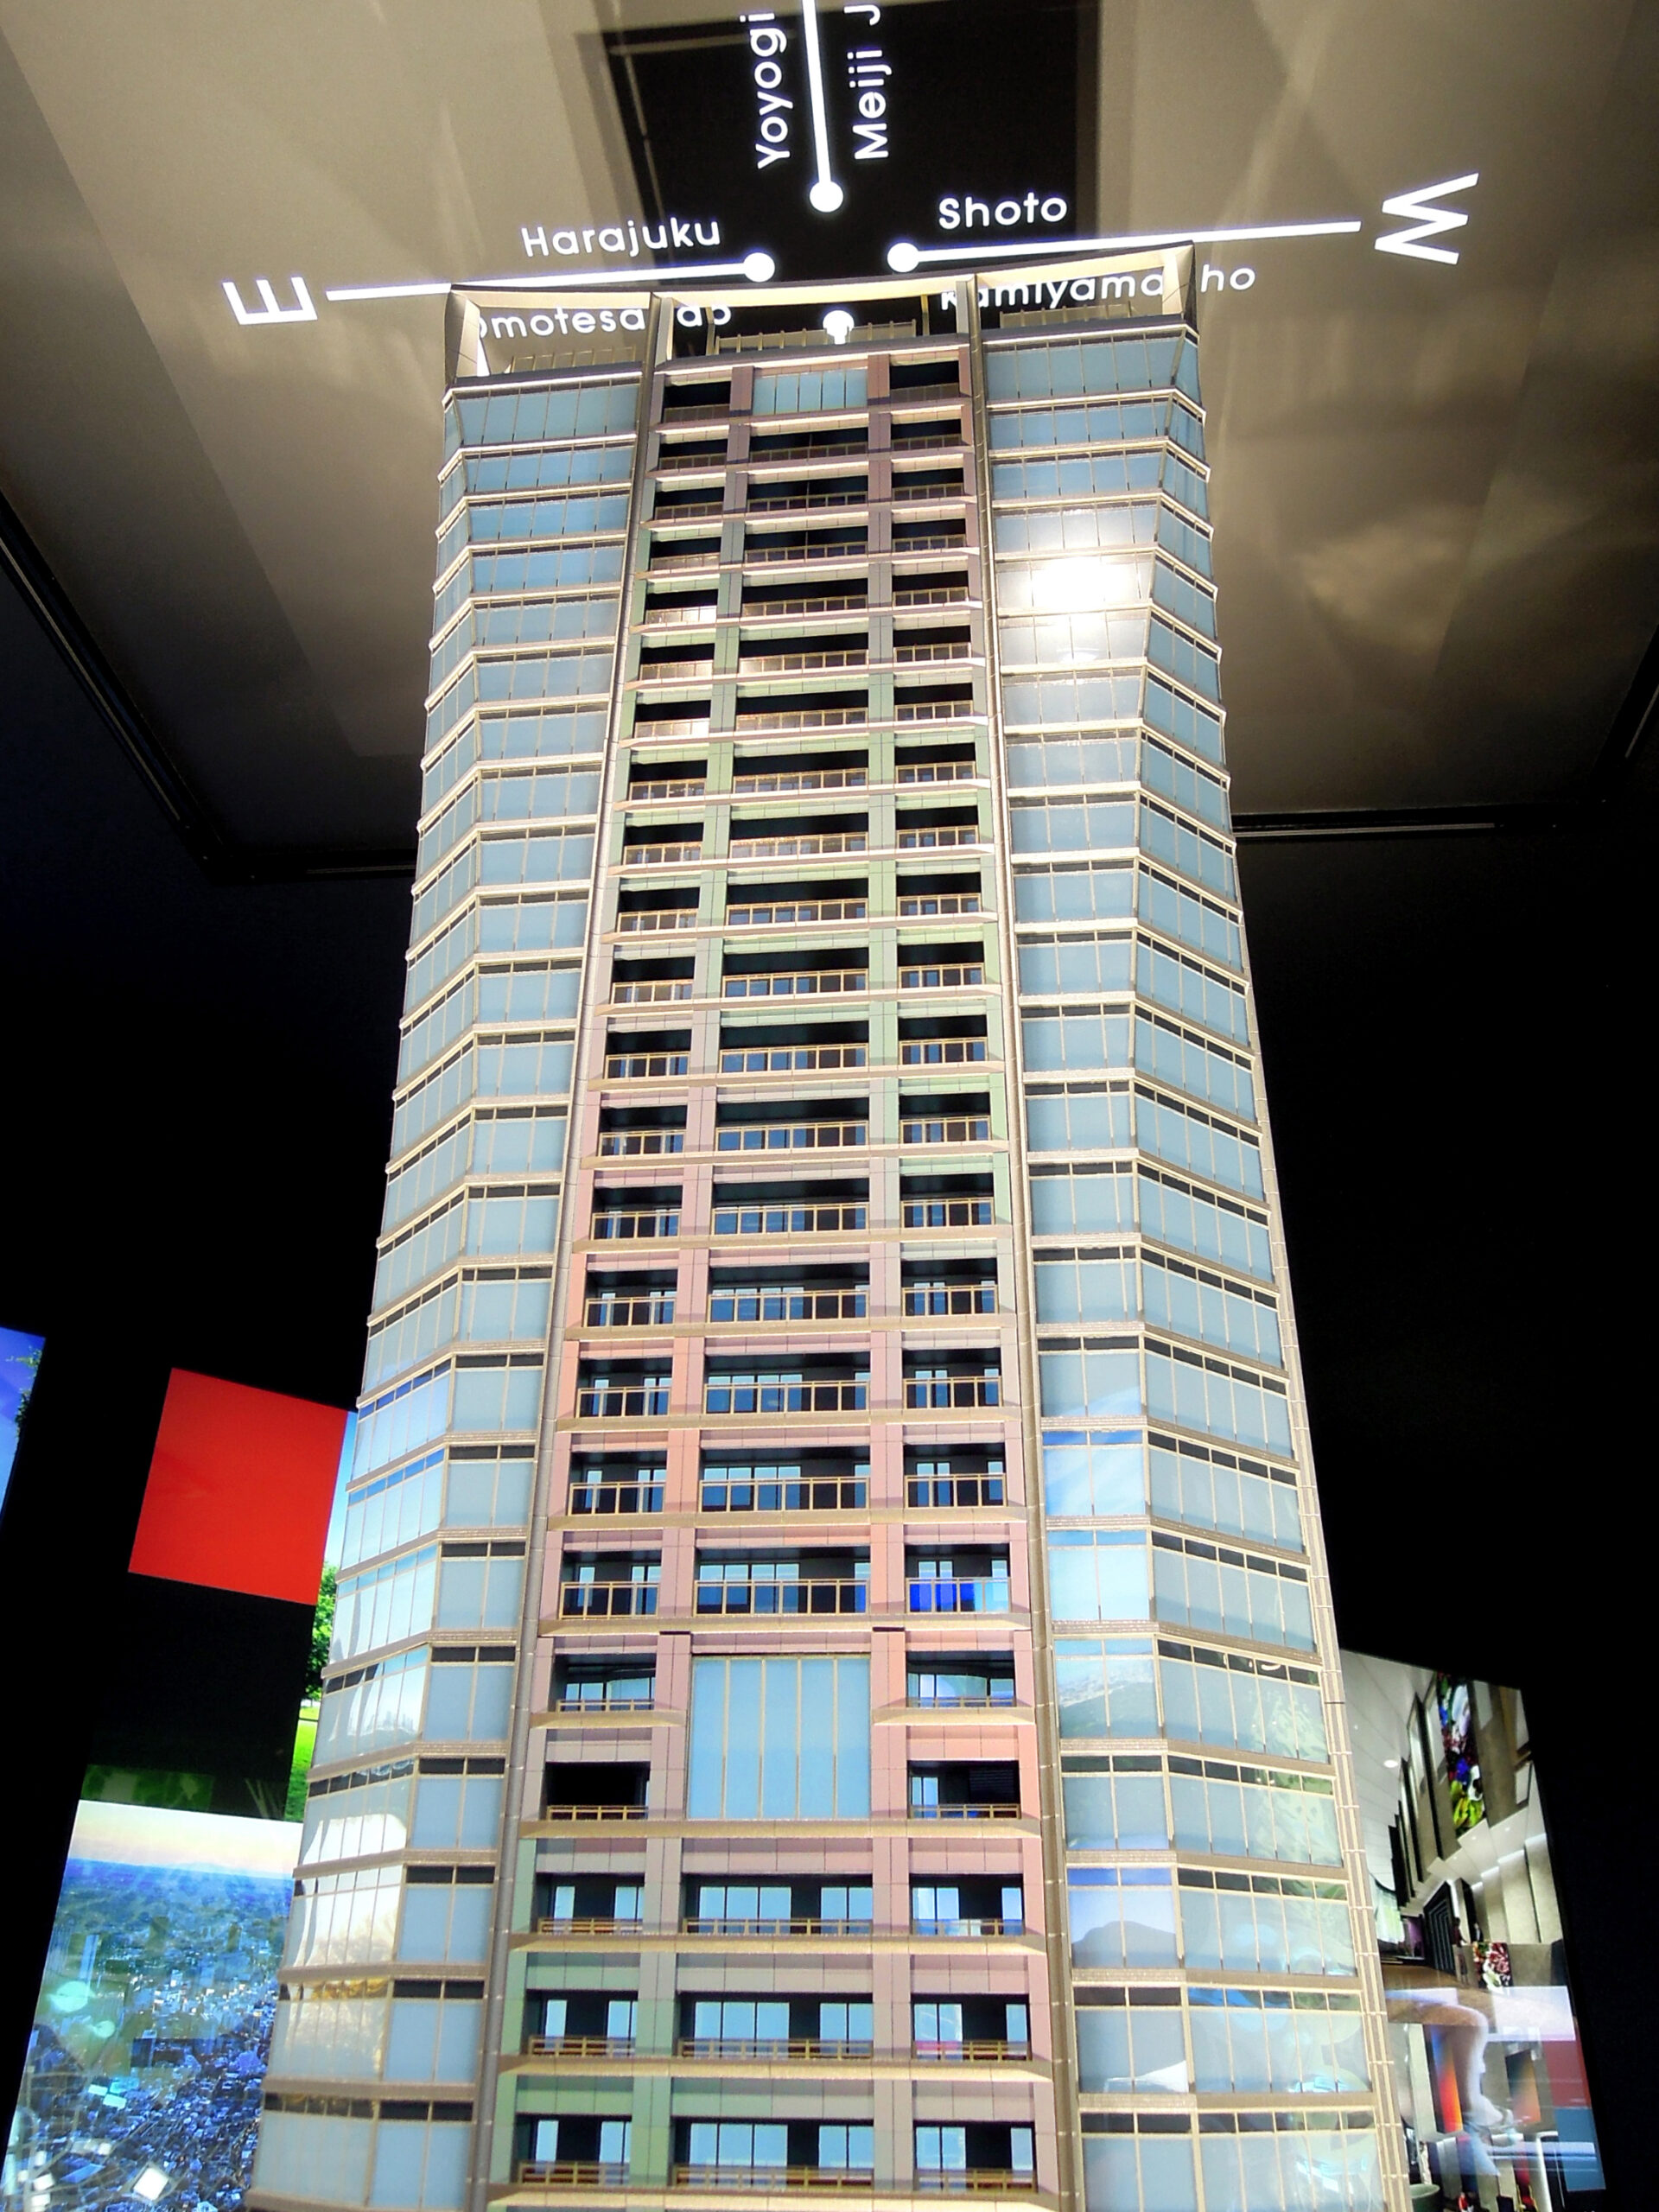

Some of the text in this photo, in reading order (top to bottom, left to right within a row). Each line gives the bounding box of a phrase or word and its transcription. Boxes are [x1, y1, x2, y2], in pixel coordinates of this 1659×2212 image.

[739, 12, 794, 169] Yoyogi
[846, 49, 893, 160] Meiji
[521, 217, 721, 257] Harajuku
[938, 192, 1068, 230] Shoto
[1375, 173, 1479, 265] W
[222, 276, 318, 325] E
